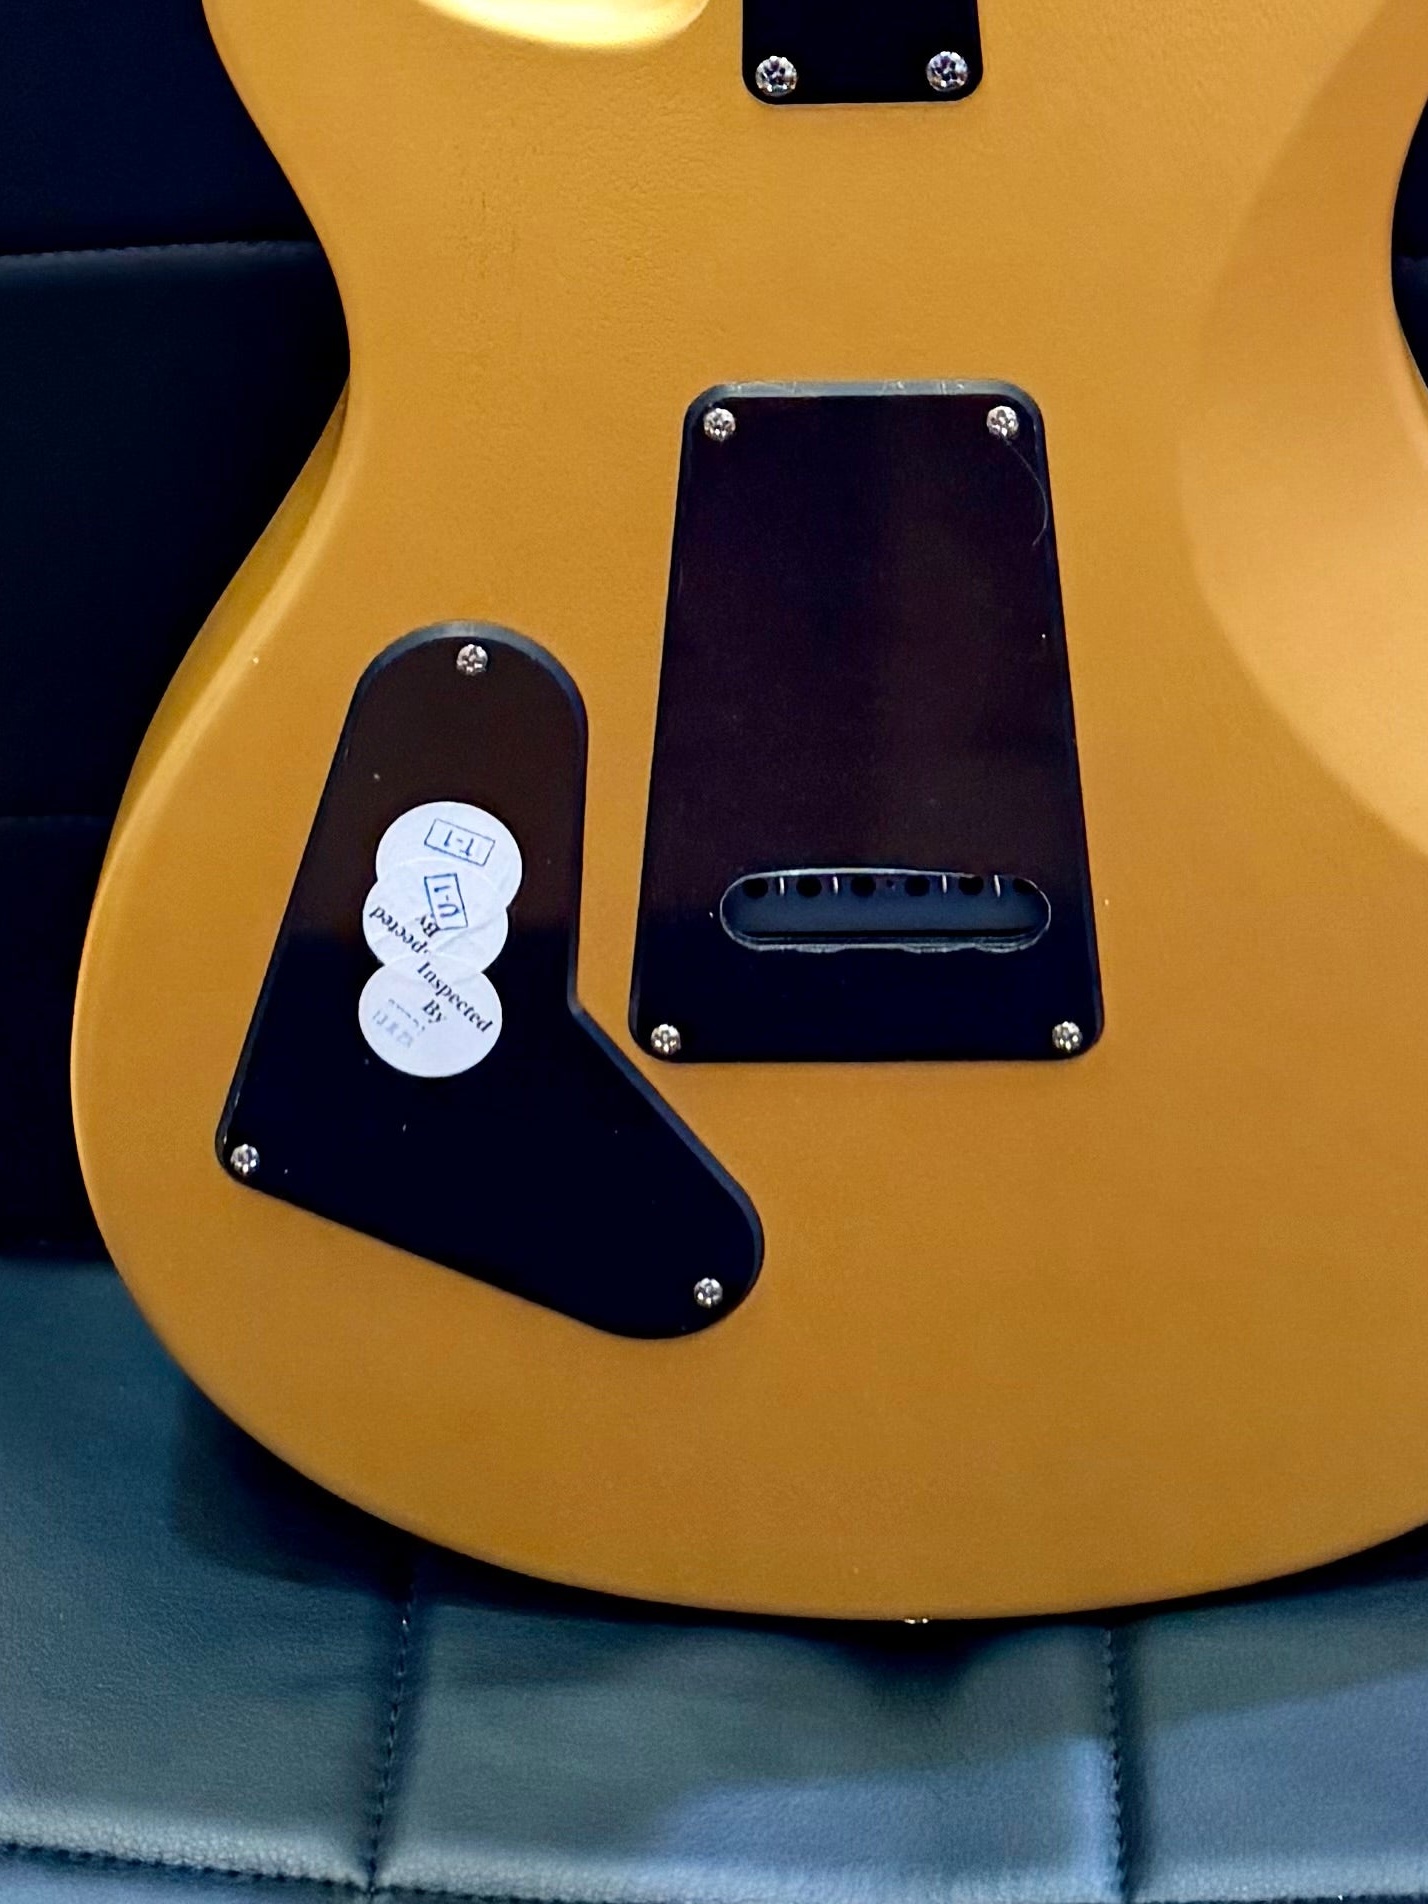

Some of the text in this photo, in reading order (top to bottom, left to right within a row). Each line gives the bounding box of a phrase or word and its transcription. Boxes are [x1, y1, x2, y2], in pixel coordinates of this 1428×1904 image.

[370, 906, 428, 954] pected
[416, 913, 440, 938] By
[417, 961, 493, 1033] Inspected
[423, 1000, 448, 1024] By
